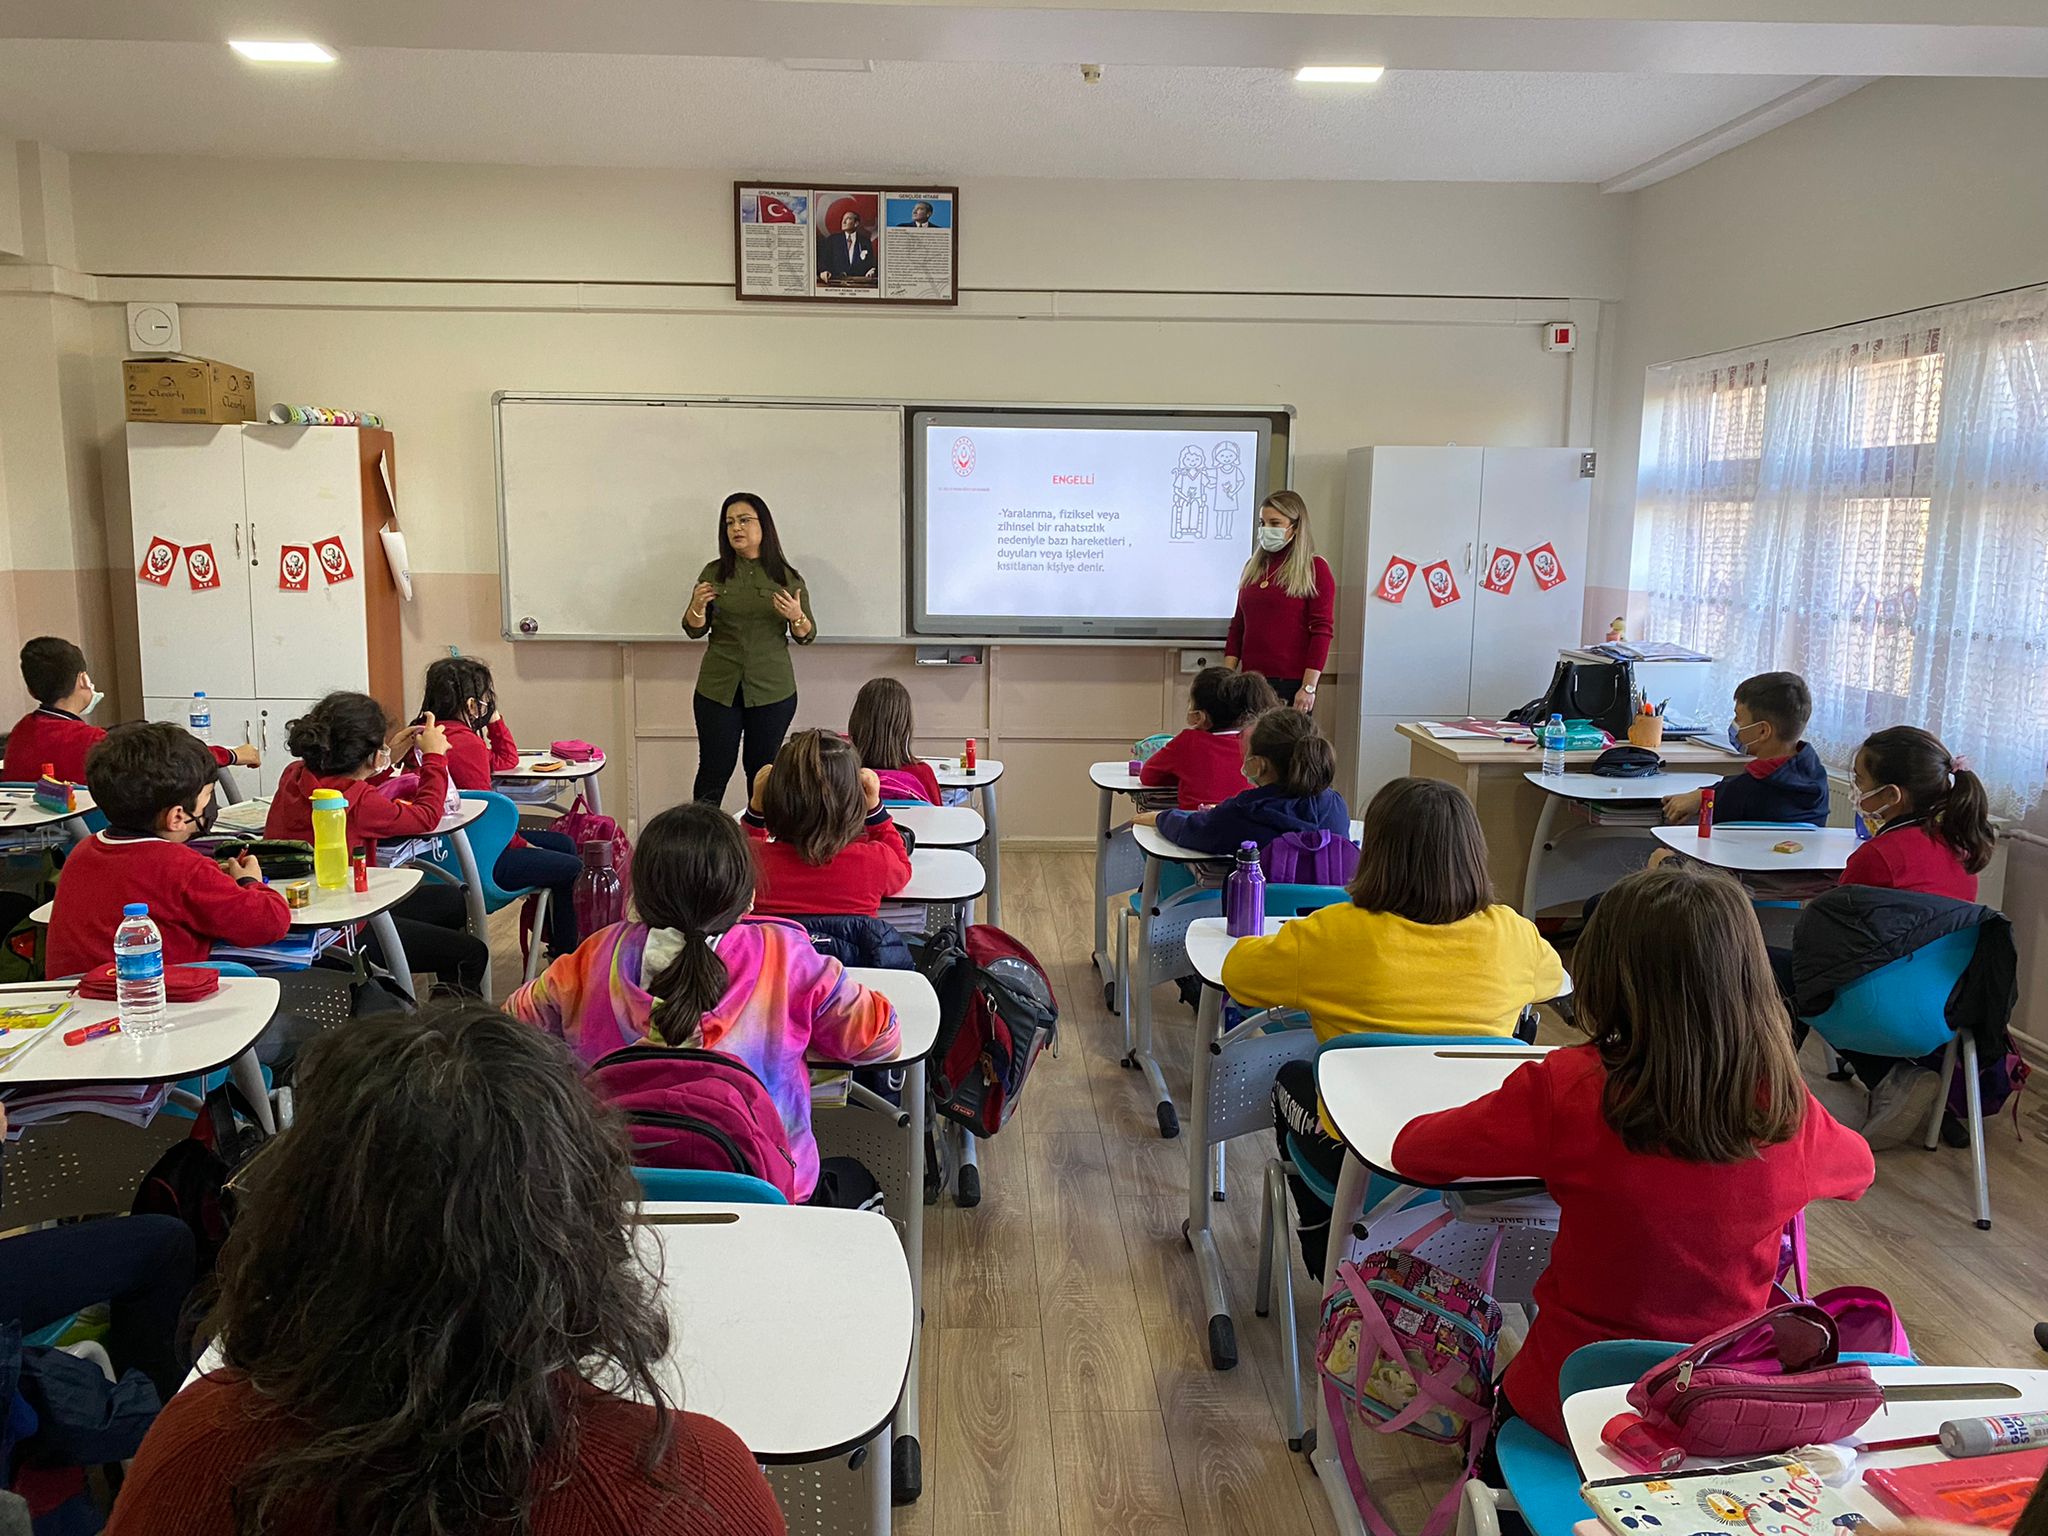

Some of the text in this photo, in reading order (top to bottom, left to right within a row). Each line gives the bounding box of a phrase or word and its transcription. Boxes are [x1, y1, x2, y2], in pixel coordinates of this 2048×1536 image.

[1052, 473, 1095, 485] ENGELLİ
[1059, 509, 1095, 520] fiziksel
[1097, 511, 1120, 521] veya
[998, 521, 1105, 533] zihinsel bir rahatsızlık
[998, 535, 1046, 547] nedeniyle
[1048, 536, 1068, 546] bazı
[1071, 536, 1125, 546] hareketleri
[997, 548, 1104, 561] duyuları veya işlevleri
[997, 561, 1105, 573] kısıtlanan kişiye denir.
